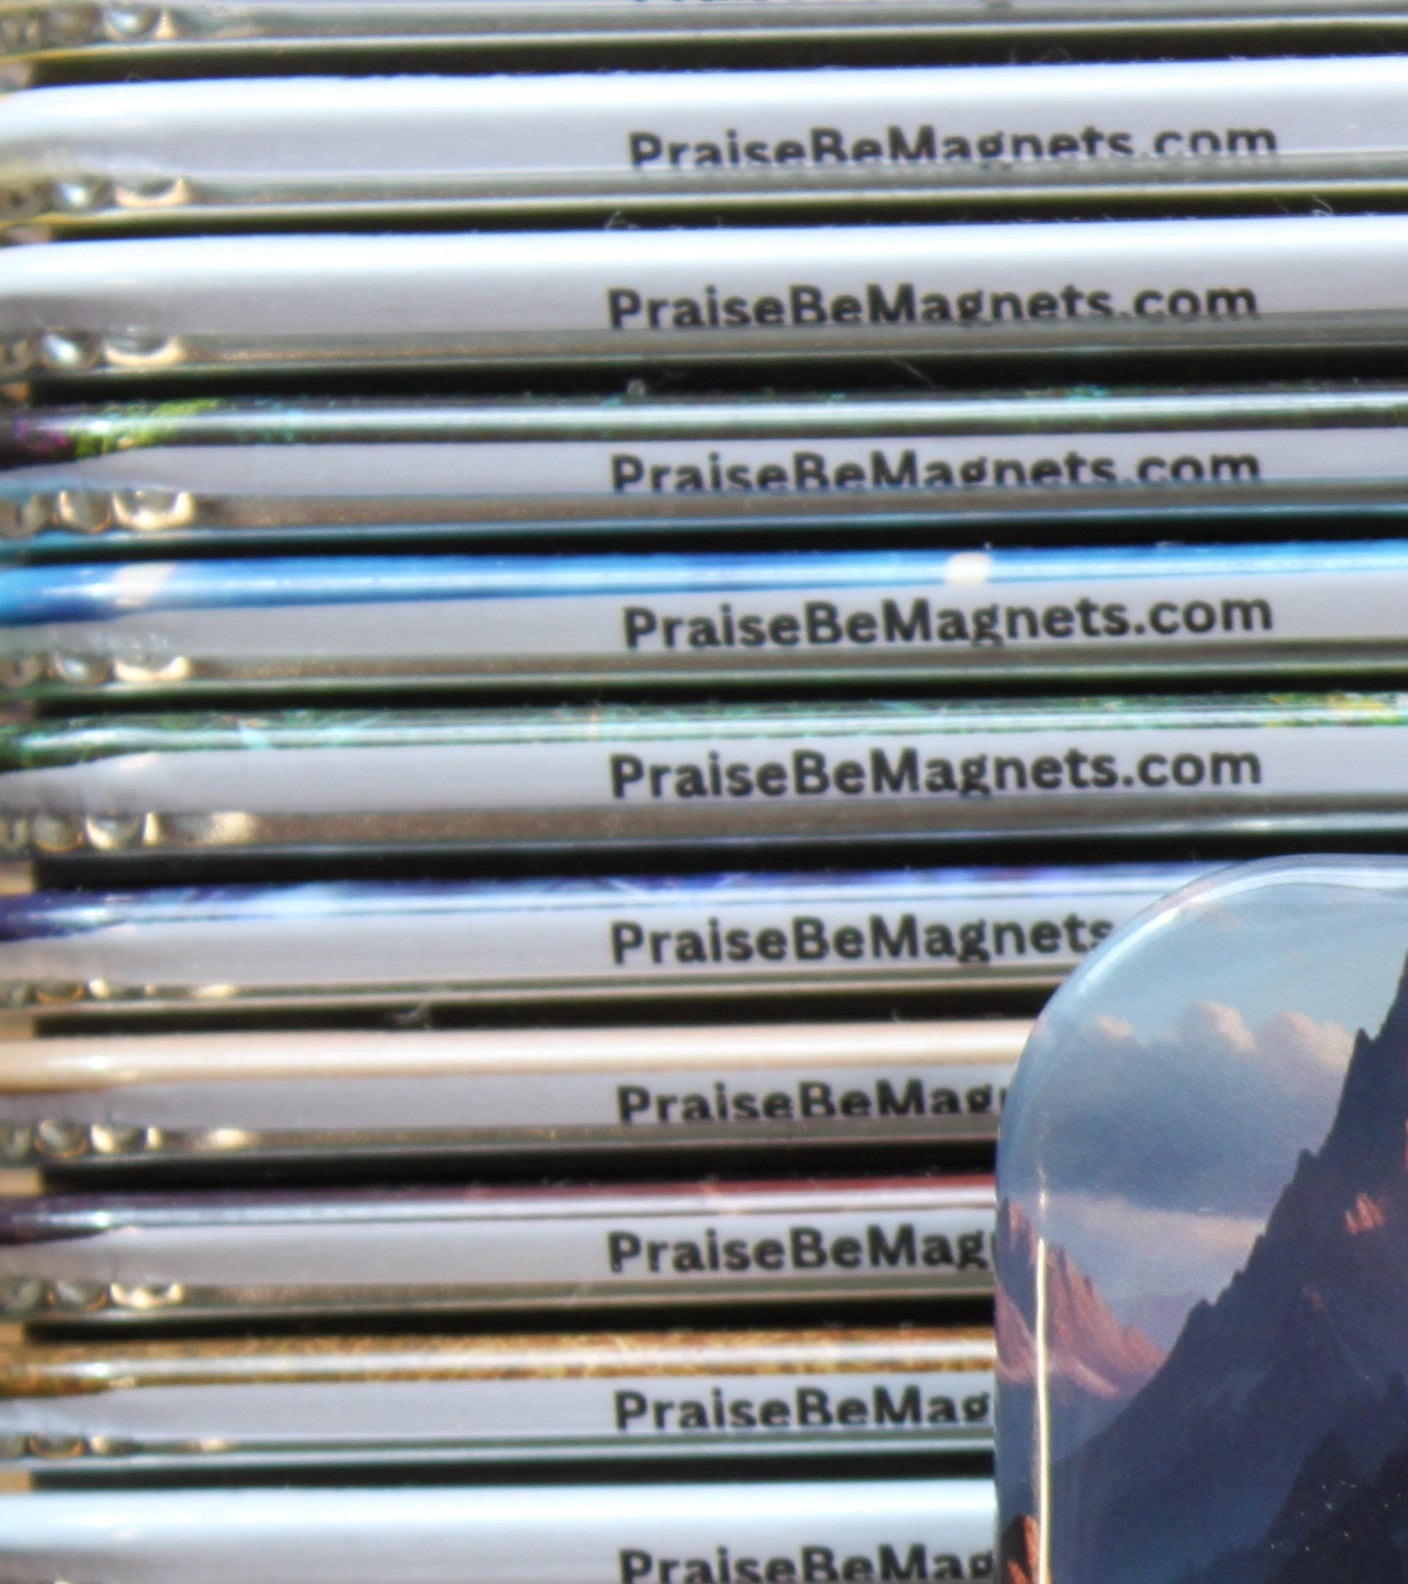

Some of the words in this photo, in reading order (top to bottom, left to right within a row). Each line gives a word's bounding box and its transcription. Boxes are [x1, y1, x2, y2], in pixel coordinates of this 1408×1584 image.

[628, 125, 1278, 169] PraiseBeMagnetscom
[607, 281, 1260, 329] PraiseBeMagnets.com
[611, 450, 1262, 496] PraiseBeMagnetscom
[622, 595, 1273, 650] PraiseBeMagnets.com
[610, 747, 1264, 800] PraiseBeMagnets.com
[616, 1078, 1008, 1125] PraiseBeMag
[607, 1224, 996, 1273] PraiseBeMag
